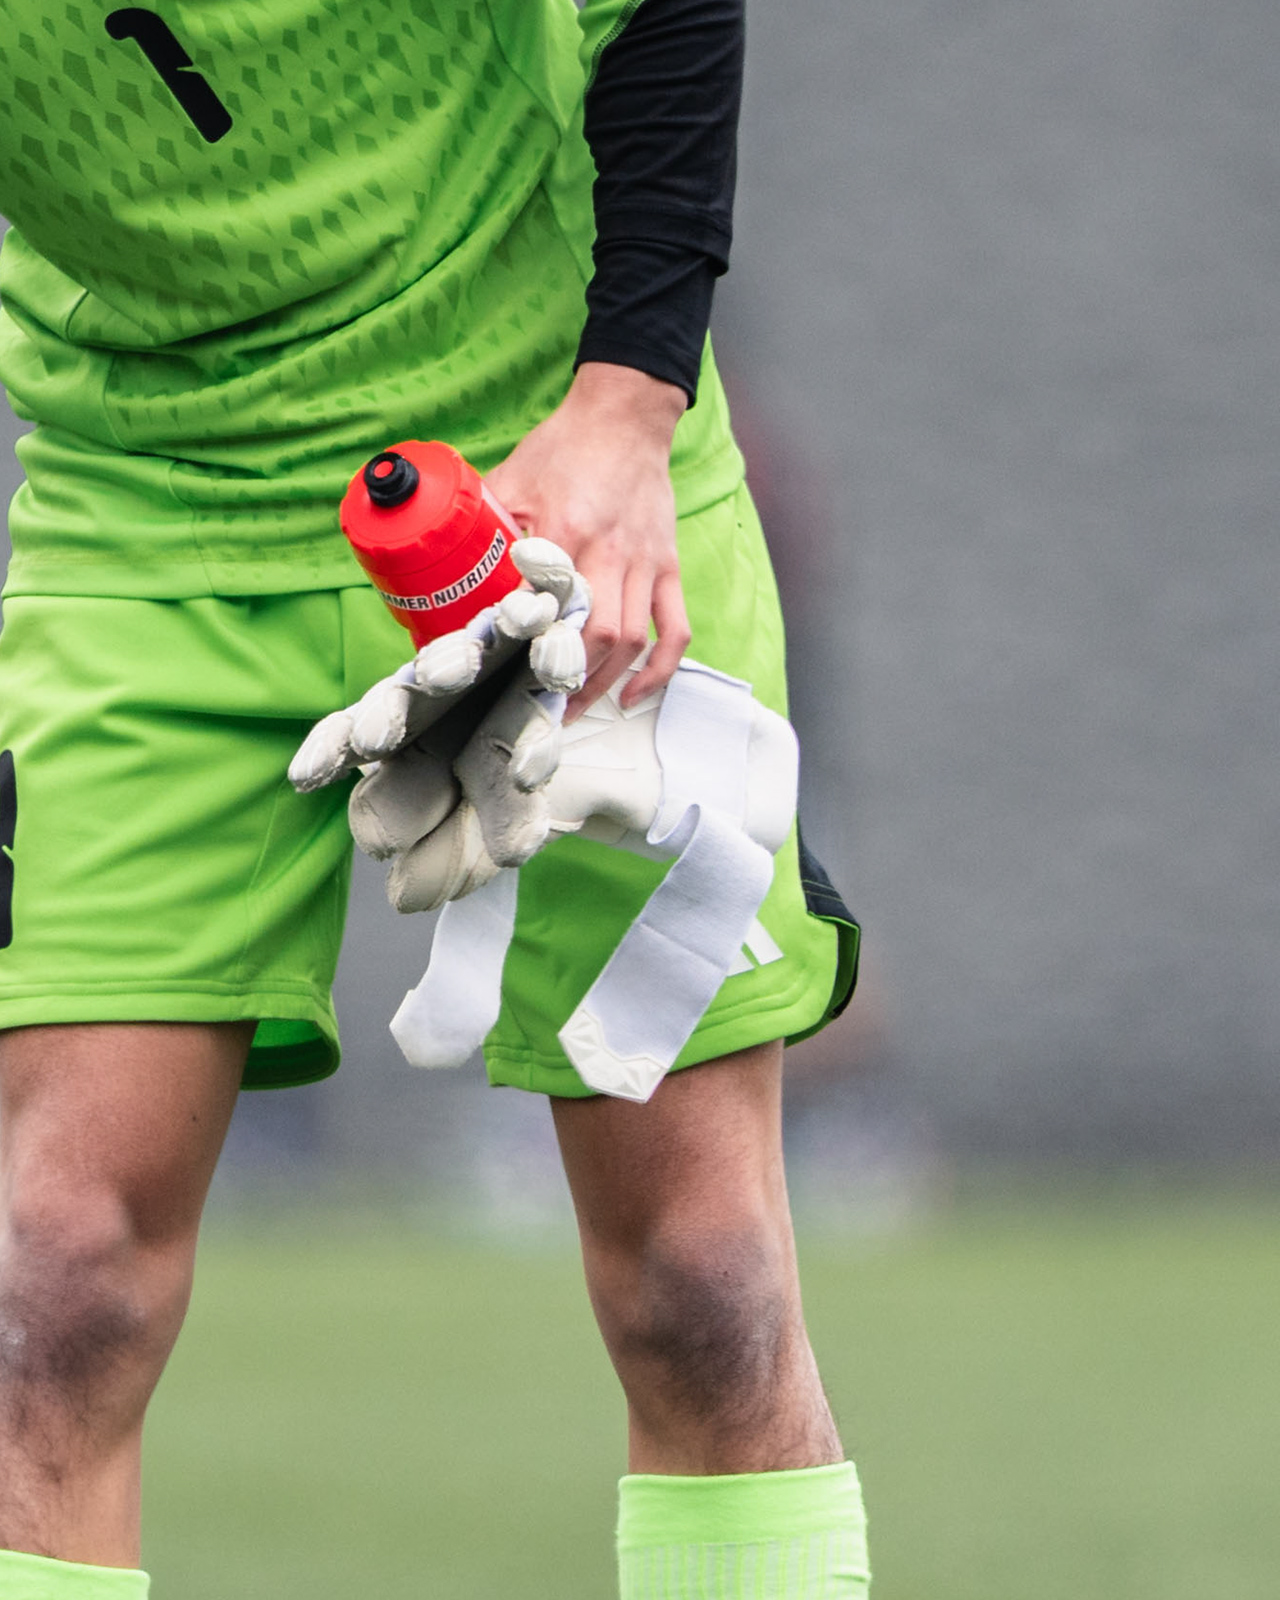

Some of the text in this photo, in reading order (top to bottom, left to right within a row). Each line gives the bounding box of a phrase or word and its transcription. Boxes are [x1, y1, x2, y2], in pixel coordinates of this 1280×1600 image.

[105, 8, 233, 144] 1
[380, 532, 506, 610] MMER NUTRITION
